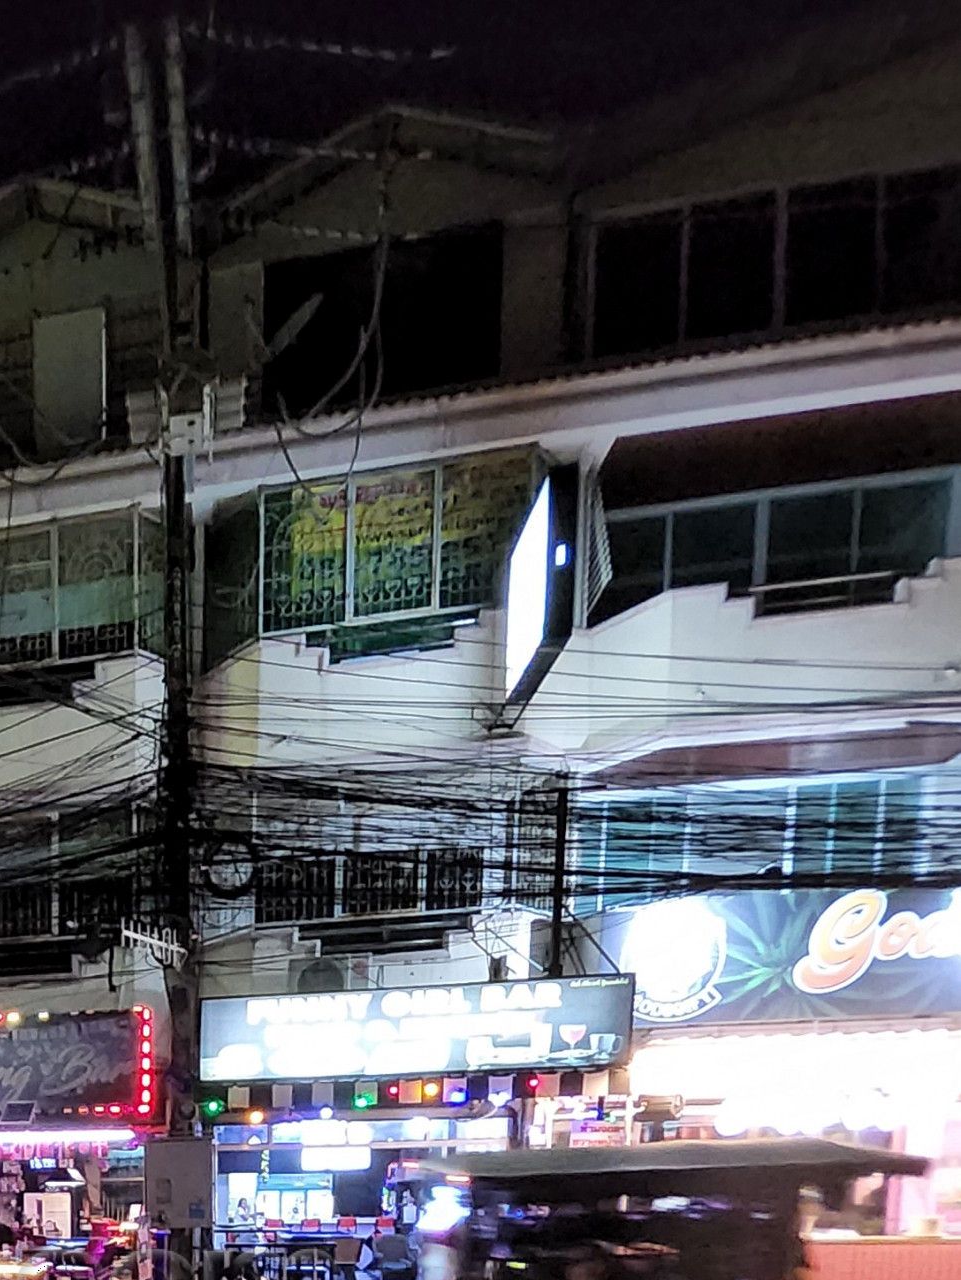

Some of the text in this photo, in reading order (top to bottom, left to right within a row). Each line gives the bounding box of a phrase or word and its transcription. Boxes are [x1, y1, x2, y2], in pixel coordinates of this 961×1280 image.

[246, 982, 563, 1026] FUNNY GIRL BAR
